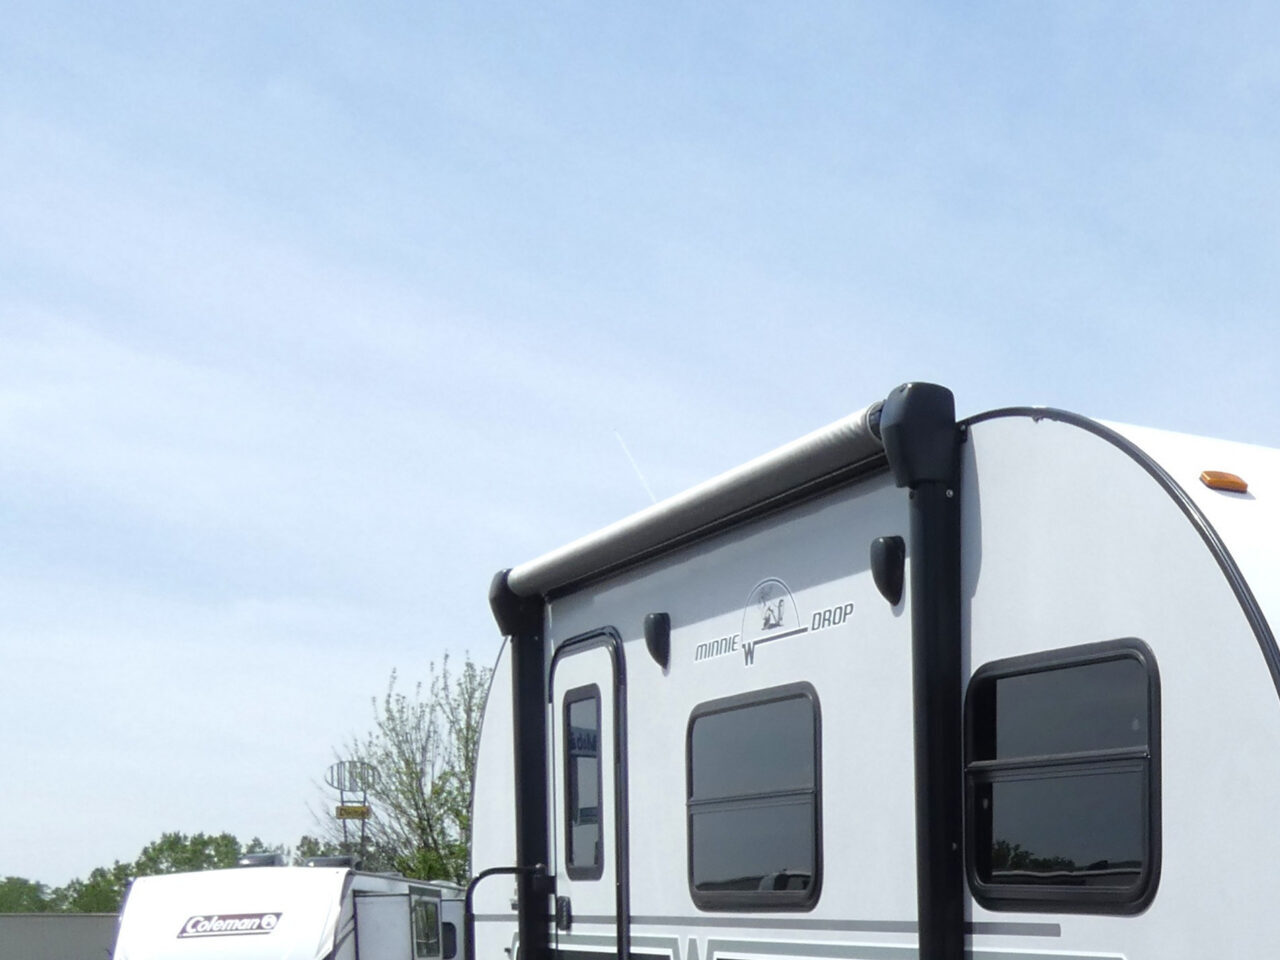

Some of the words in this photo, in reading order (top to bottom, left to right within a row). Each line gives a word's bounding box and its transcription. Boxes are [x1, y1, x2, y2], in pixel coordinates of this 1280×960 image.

[811, 603, 854, 631] DROP
[695, 633, 741, 661] MINNIE
[186, 916, 261, 934] Coleman
